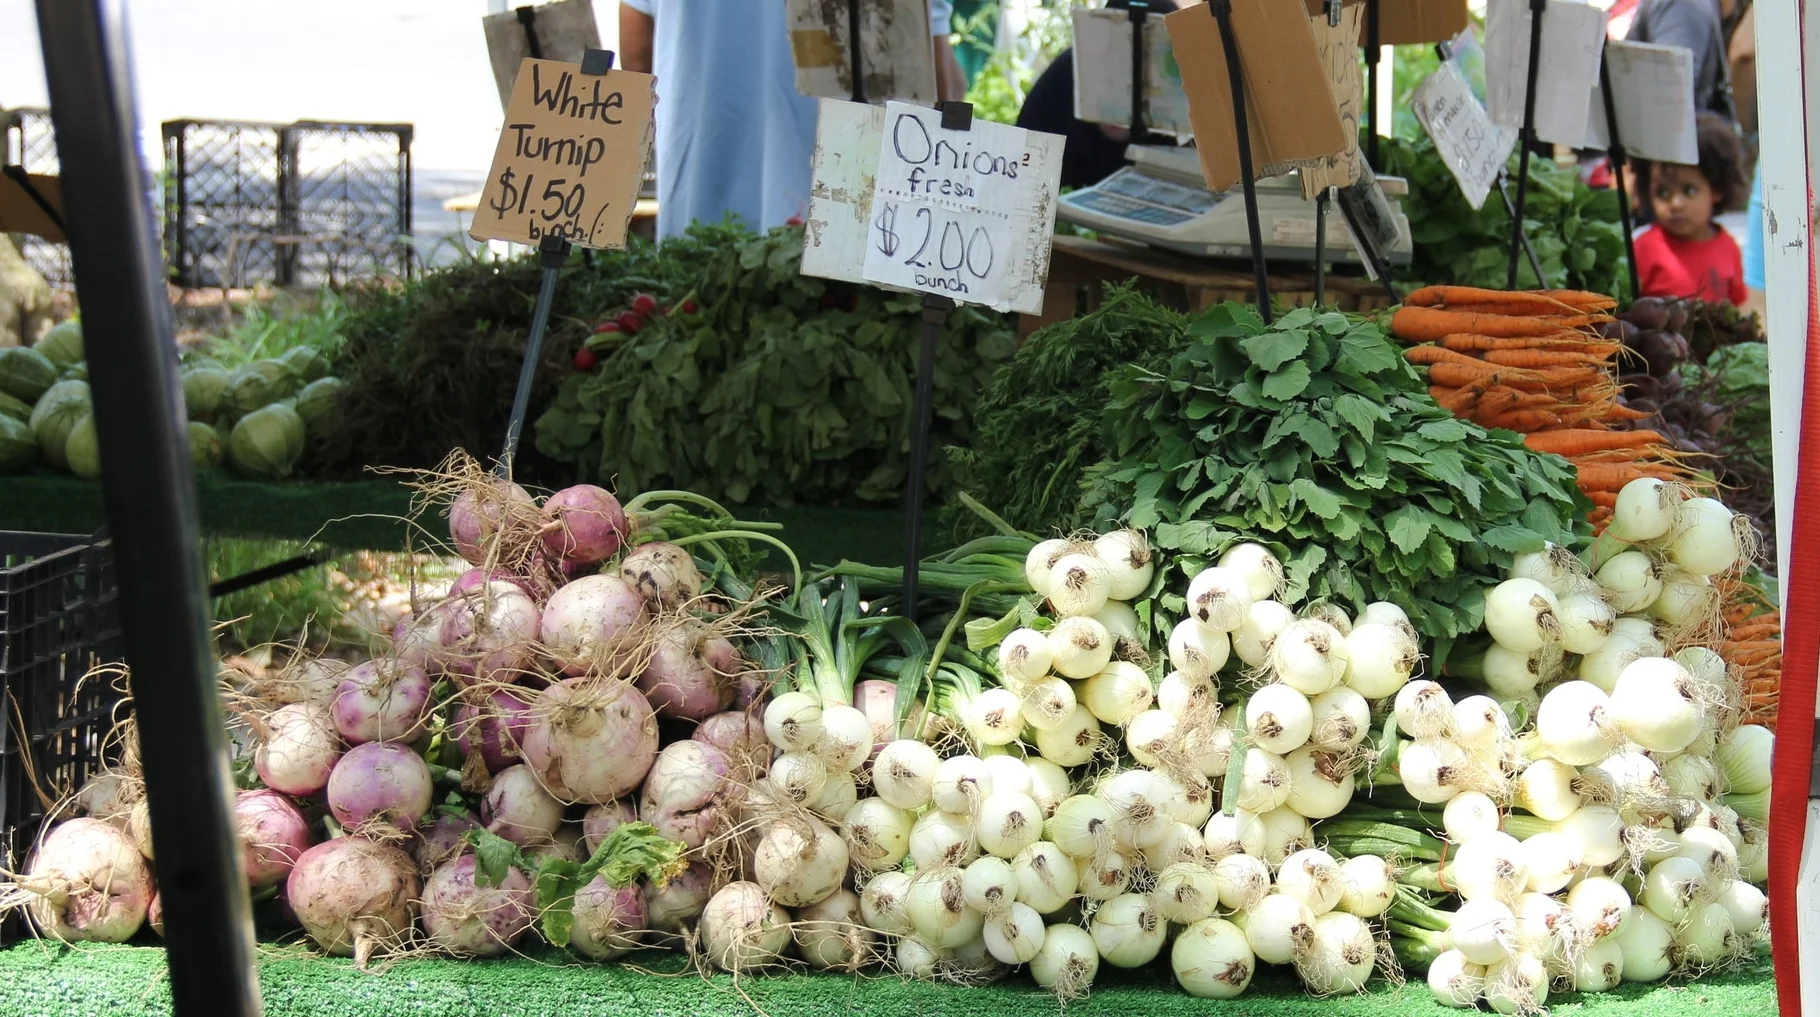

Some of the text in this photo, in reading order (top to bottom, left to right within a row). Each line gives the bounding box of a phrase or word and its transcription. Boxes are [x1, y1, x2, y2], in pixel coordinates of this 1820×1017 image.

[533, 63, 623, 125] White
[509, 124, 606, 178] Turnip
[490, 167, 585, 220] $1.50
[907, 166, 975, 198] fresh
[875, 201, 994, 280] $2.00
[914, 269, 970, 294] bunch
